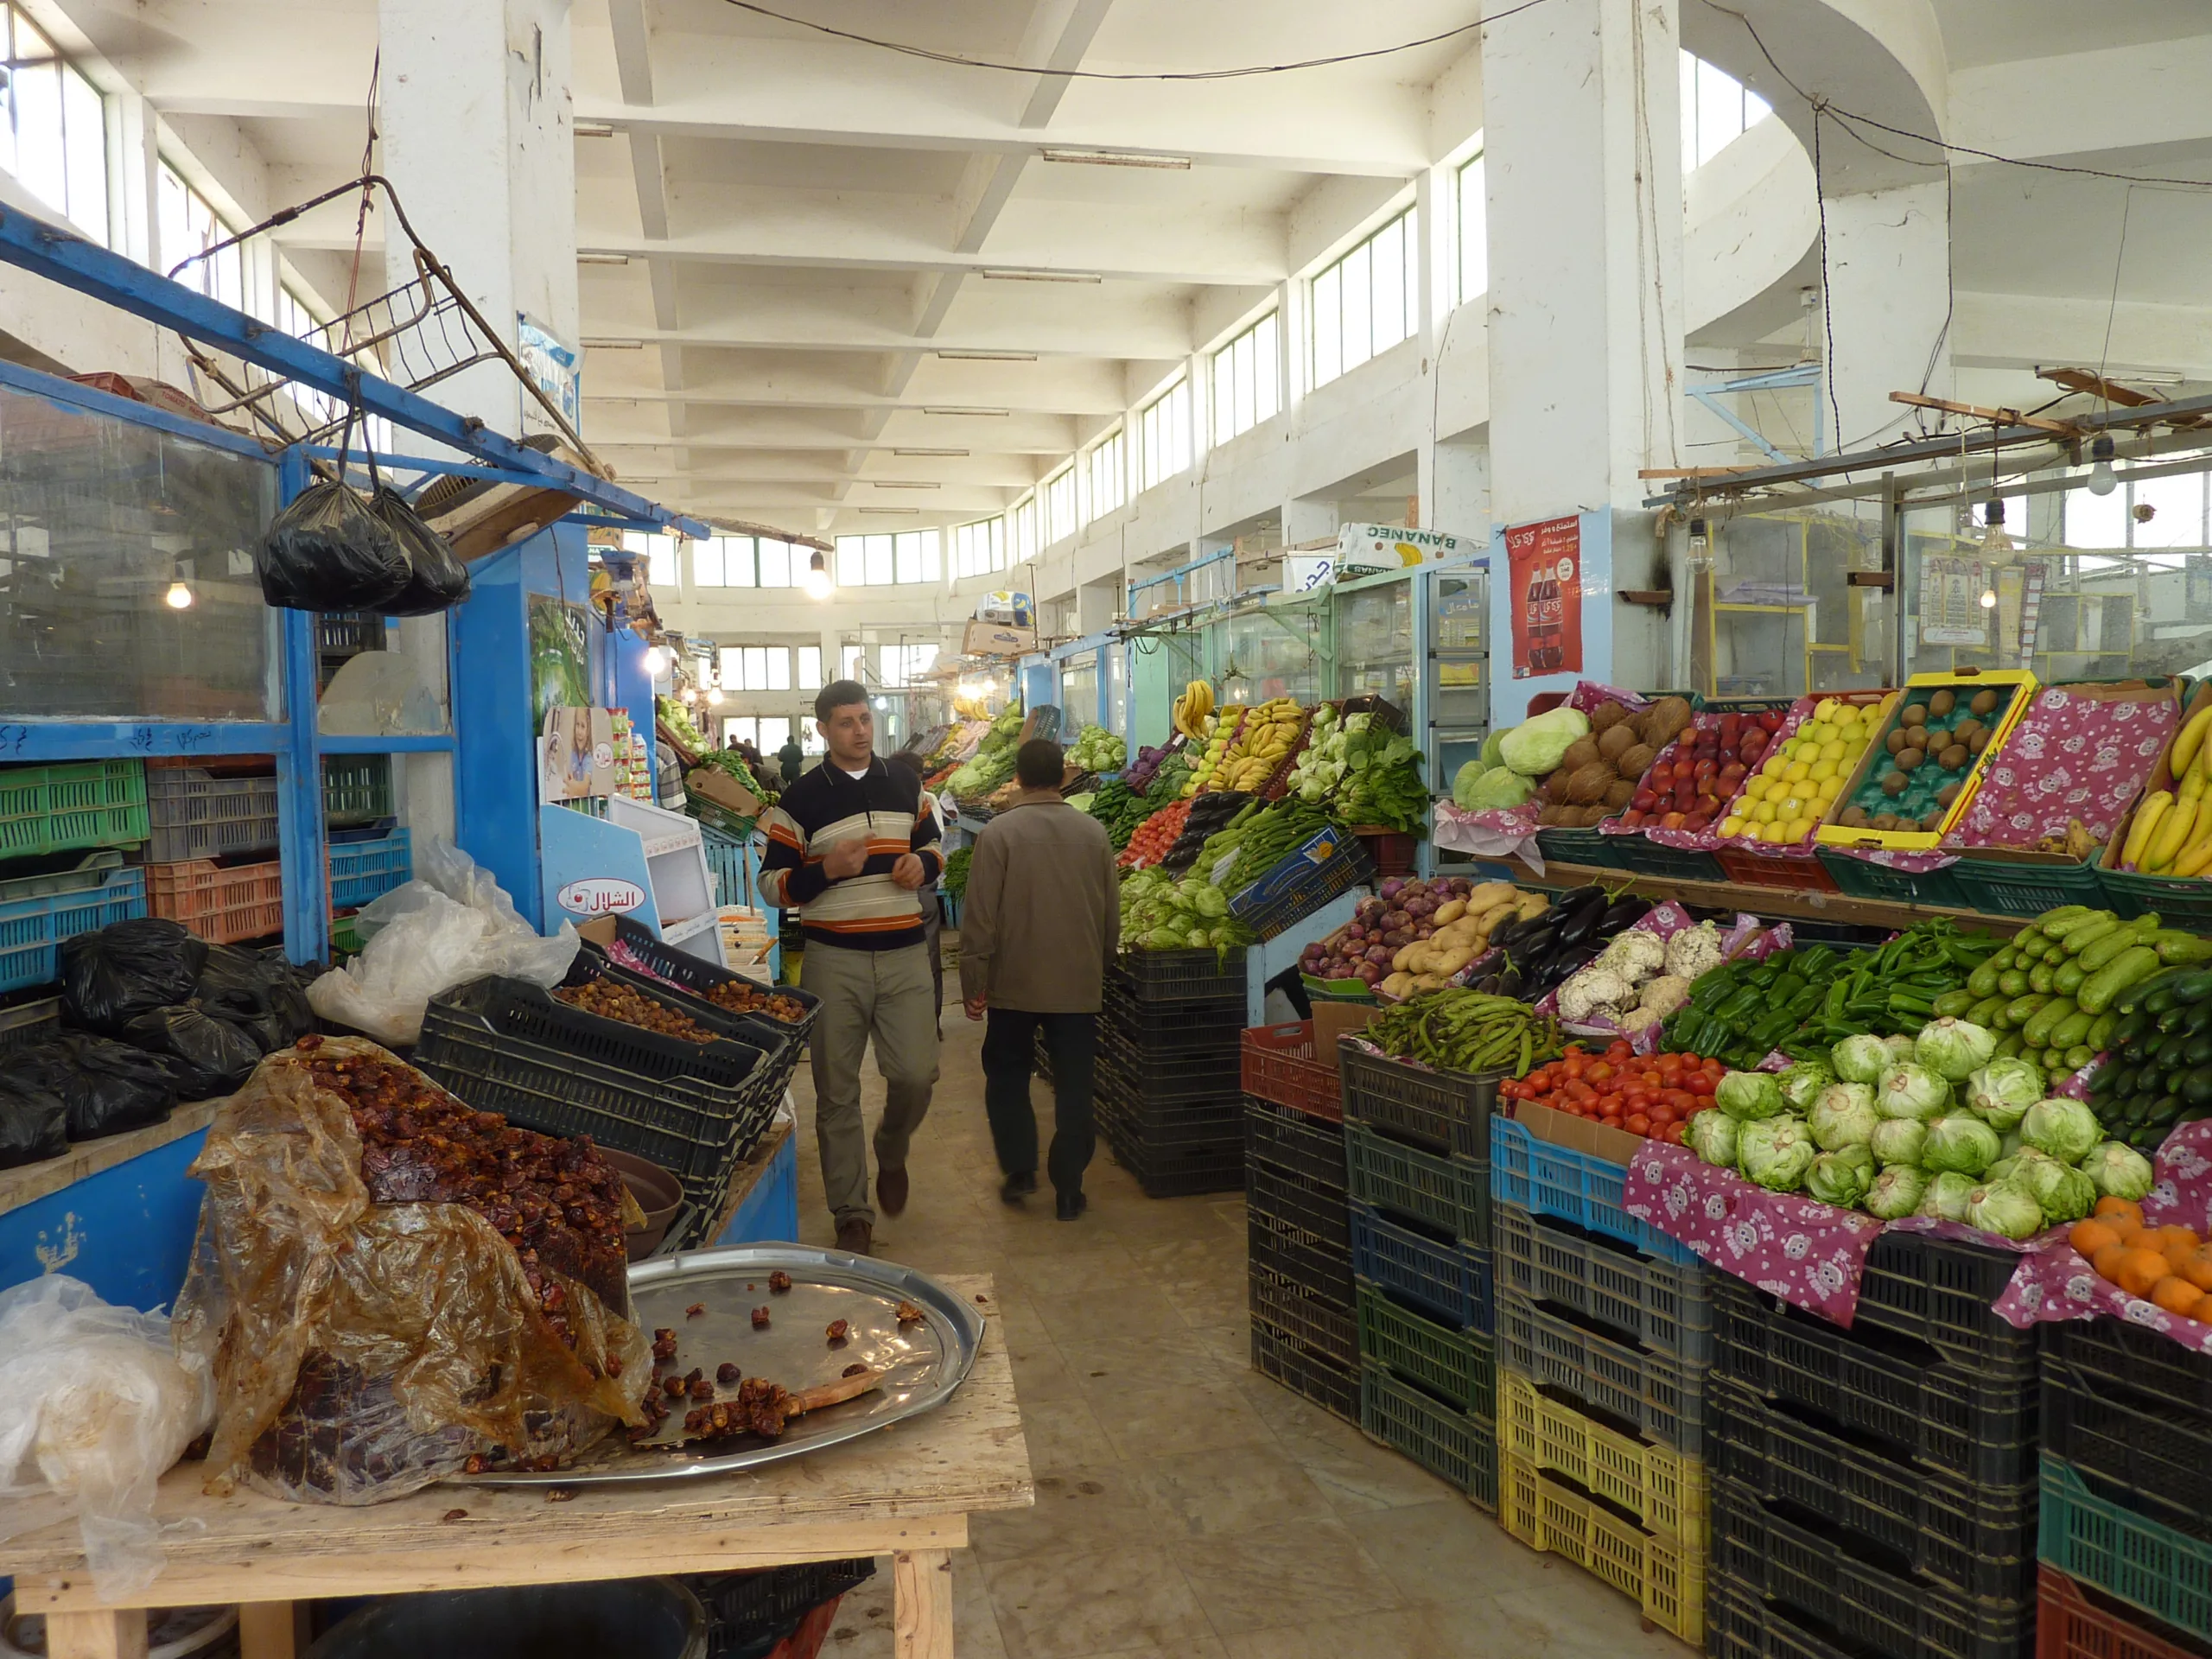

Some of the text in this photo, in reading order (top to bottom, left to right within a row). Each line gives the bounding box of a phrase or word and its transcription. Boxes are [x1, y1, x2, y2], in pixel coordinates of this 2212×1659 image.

[162, 391, 186, 408] TOMATO
[1368, 526, 1457, 549] BANANEC
[590, 891, 635, 911] الشلال
